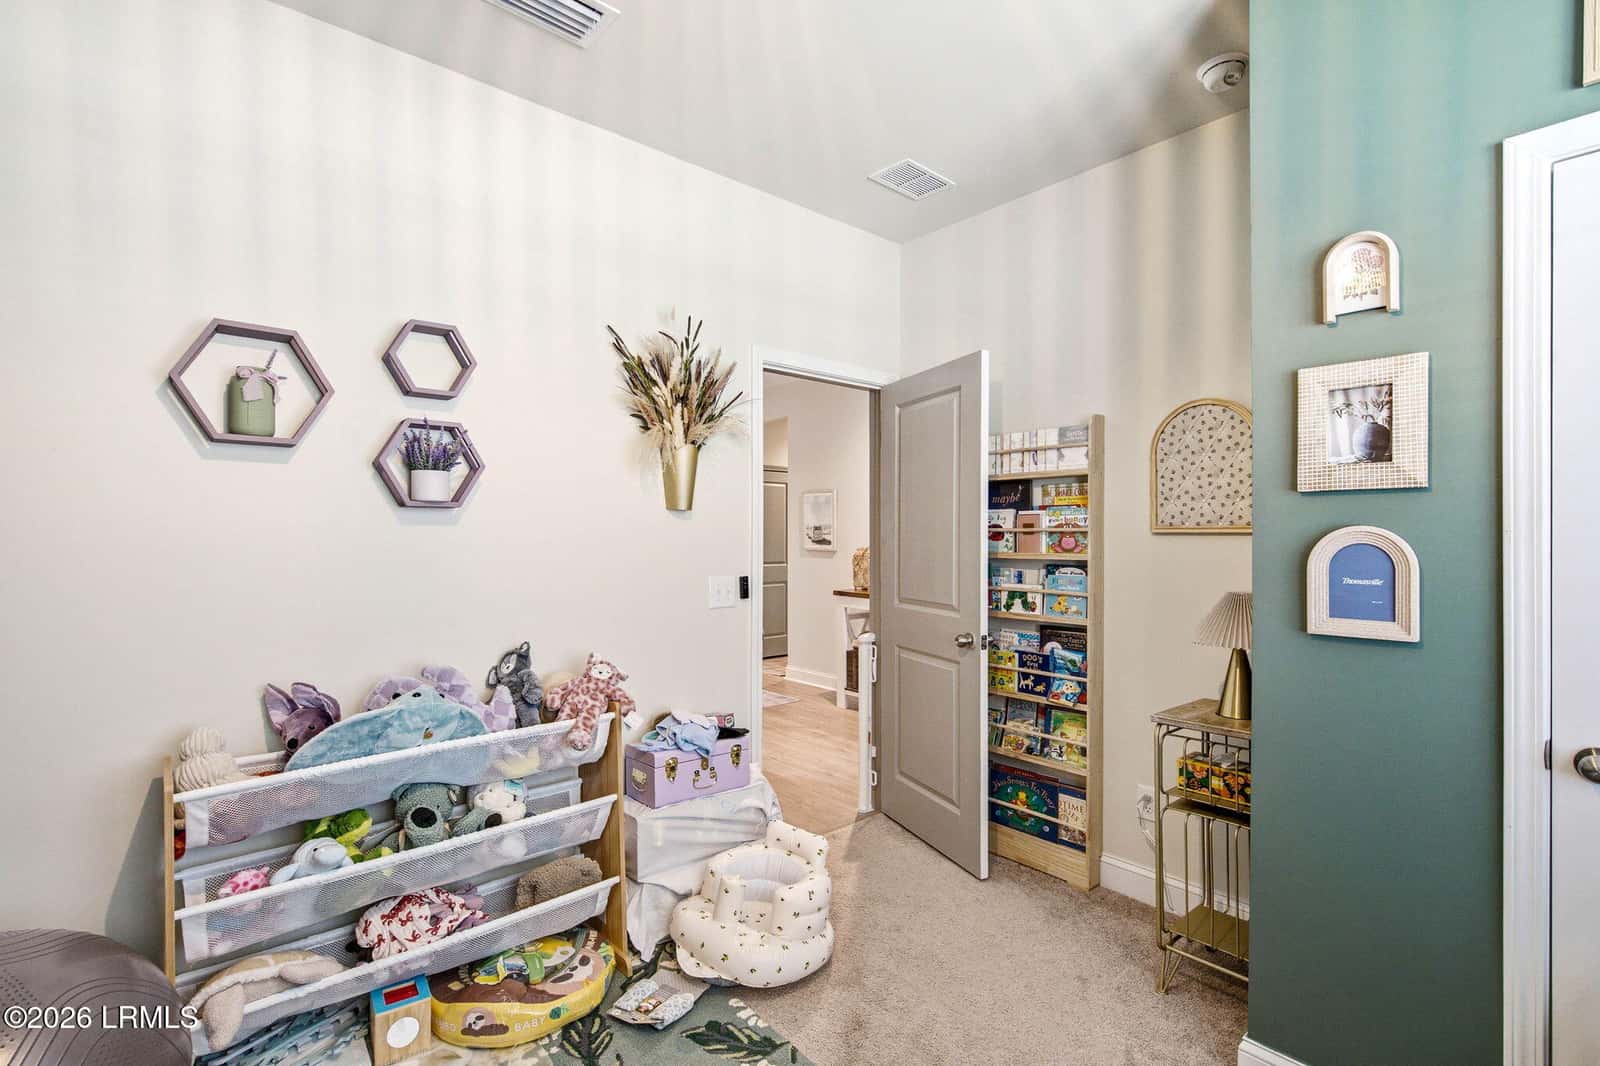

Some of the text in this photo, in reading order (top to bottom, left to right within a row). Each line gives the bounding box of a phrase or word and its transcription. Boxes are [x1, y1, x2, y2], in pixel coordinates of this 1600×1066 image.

[991, 494, 1020, 505] maybe
[1342, 576, 1384, 585] Thomasville
[514, 1016, 547, 1032] BABY
